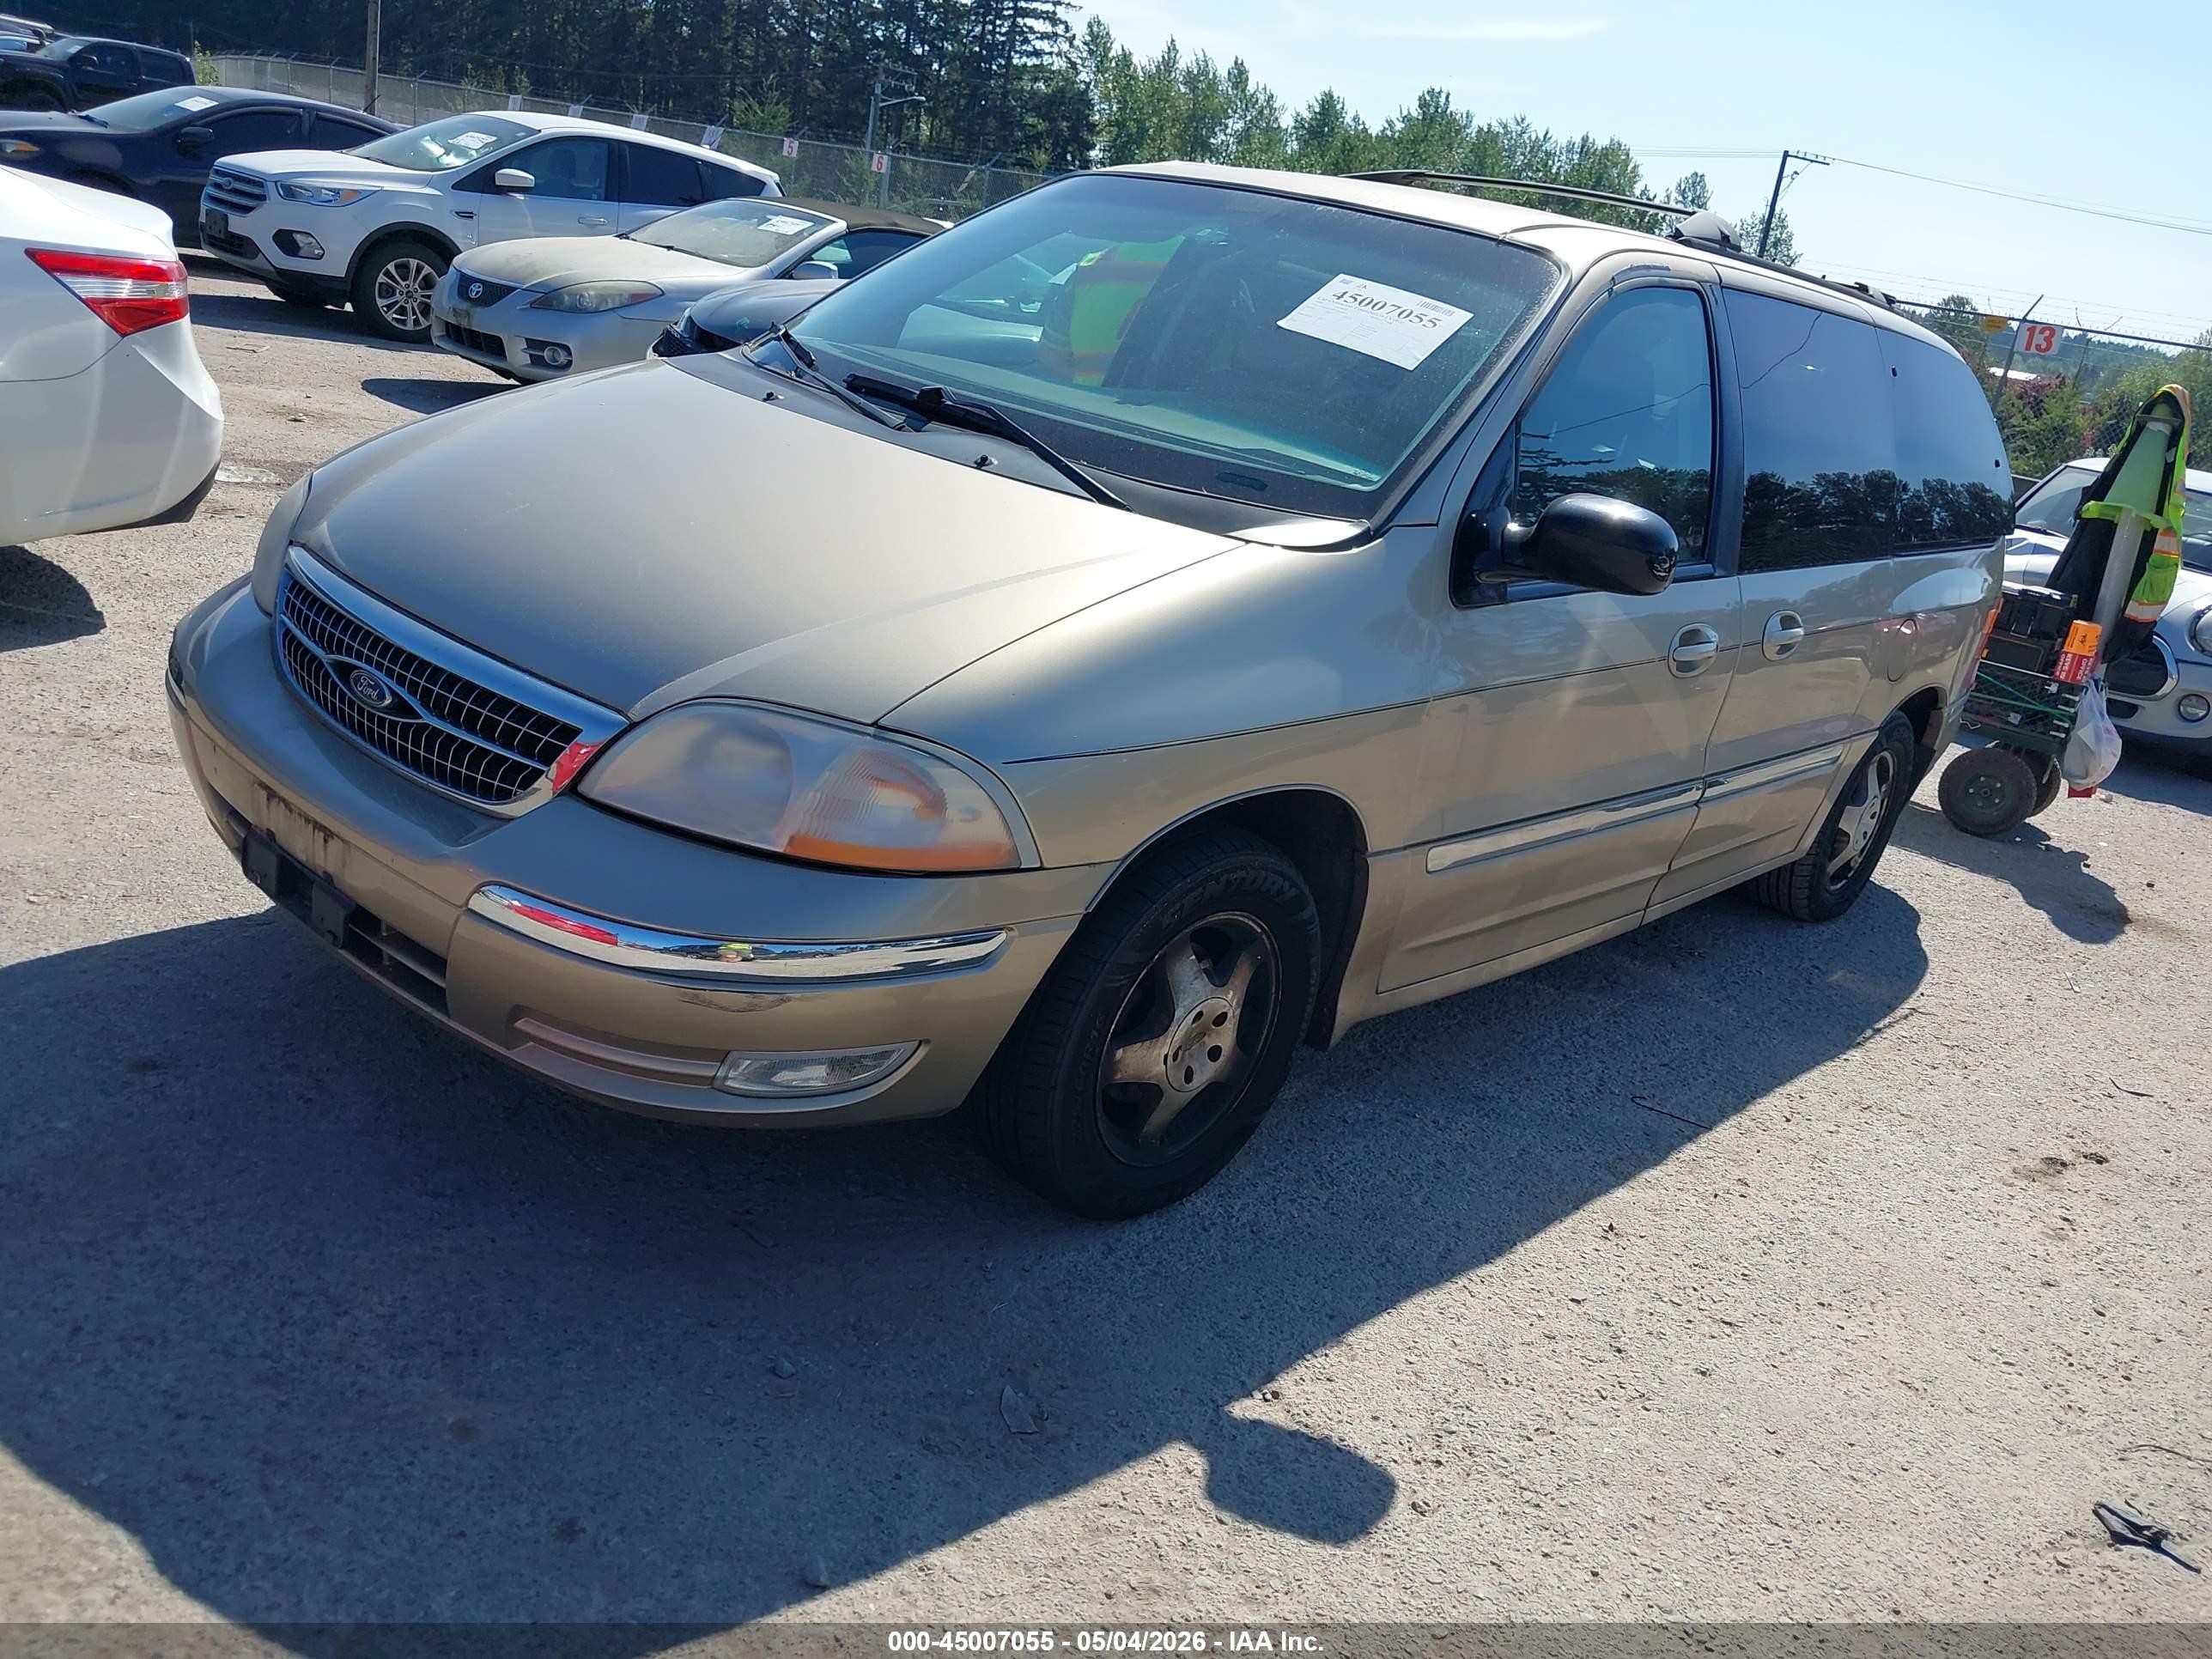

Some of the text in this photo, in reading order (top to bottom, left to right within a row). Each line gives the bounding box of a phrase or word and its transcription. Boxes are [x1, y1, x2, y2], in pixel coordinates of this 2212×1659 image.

[787, 140, 793, 155] 5
[876, 155, 884, 171] 6
[1332, 290, 1443, 329] 45007055
[2024, 325, 2057, 354] 13
[357, 676, 380, 700] Ford
